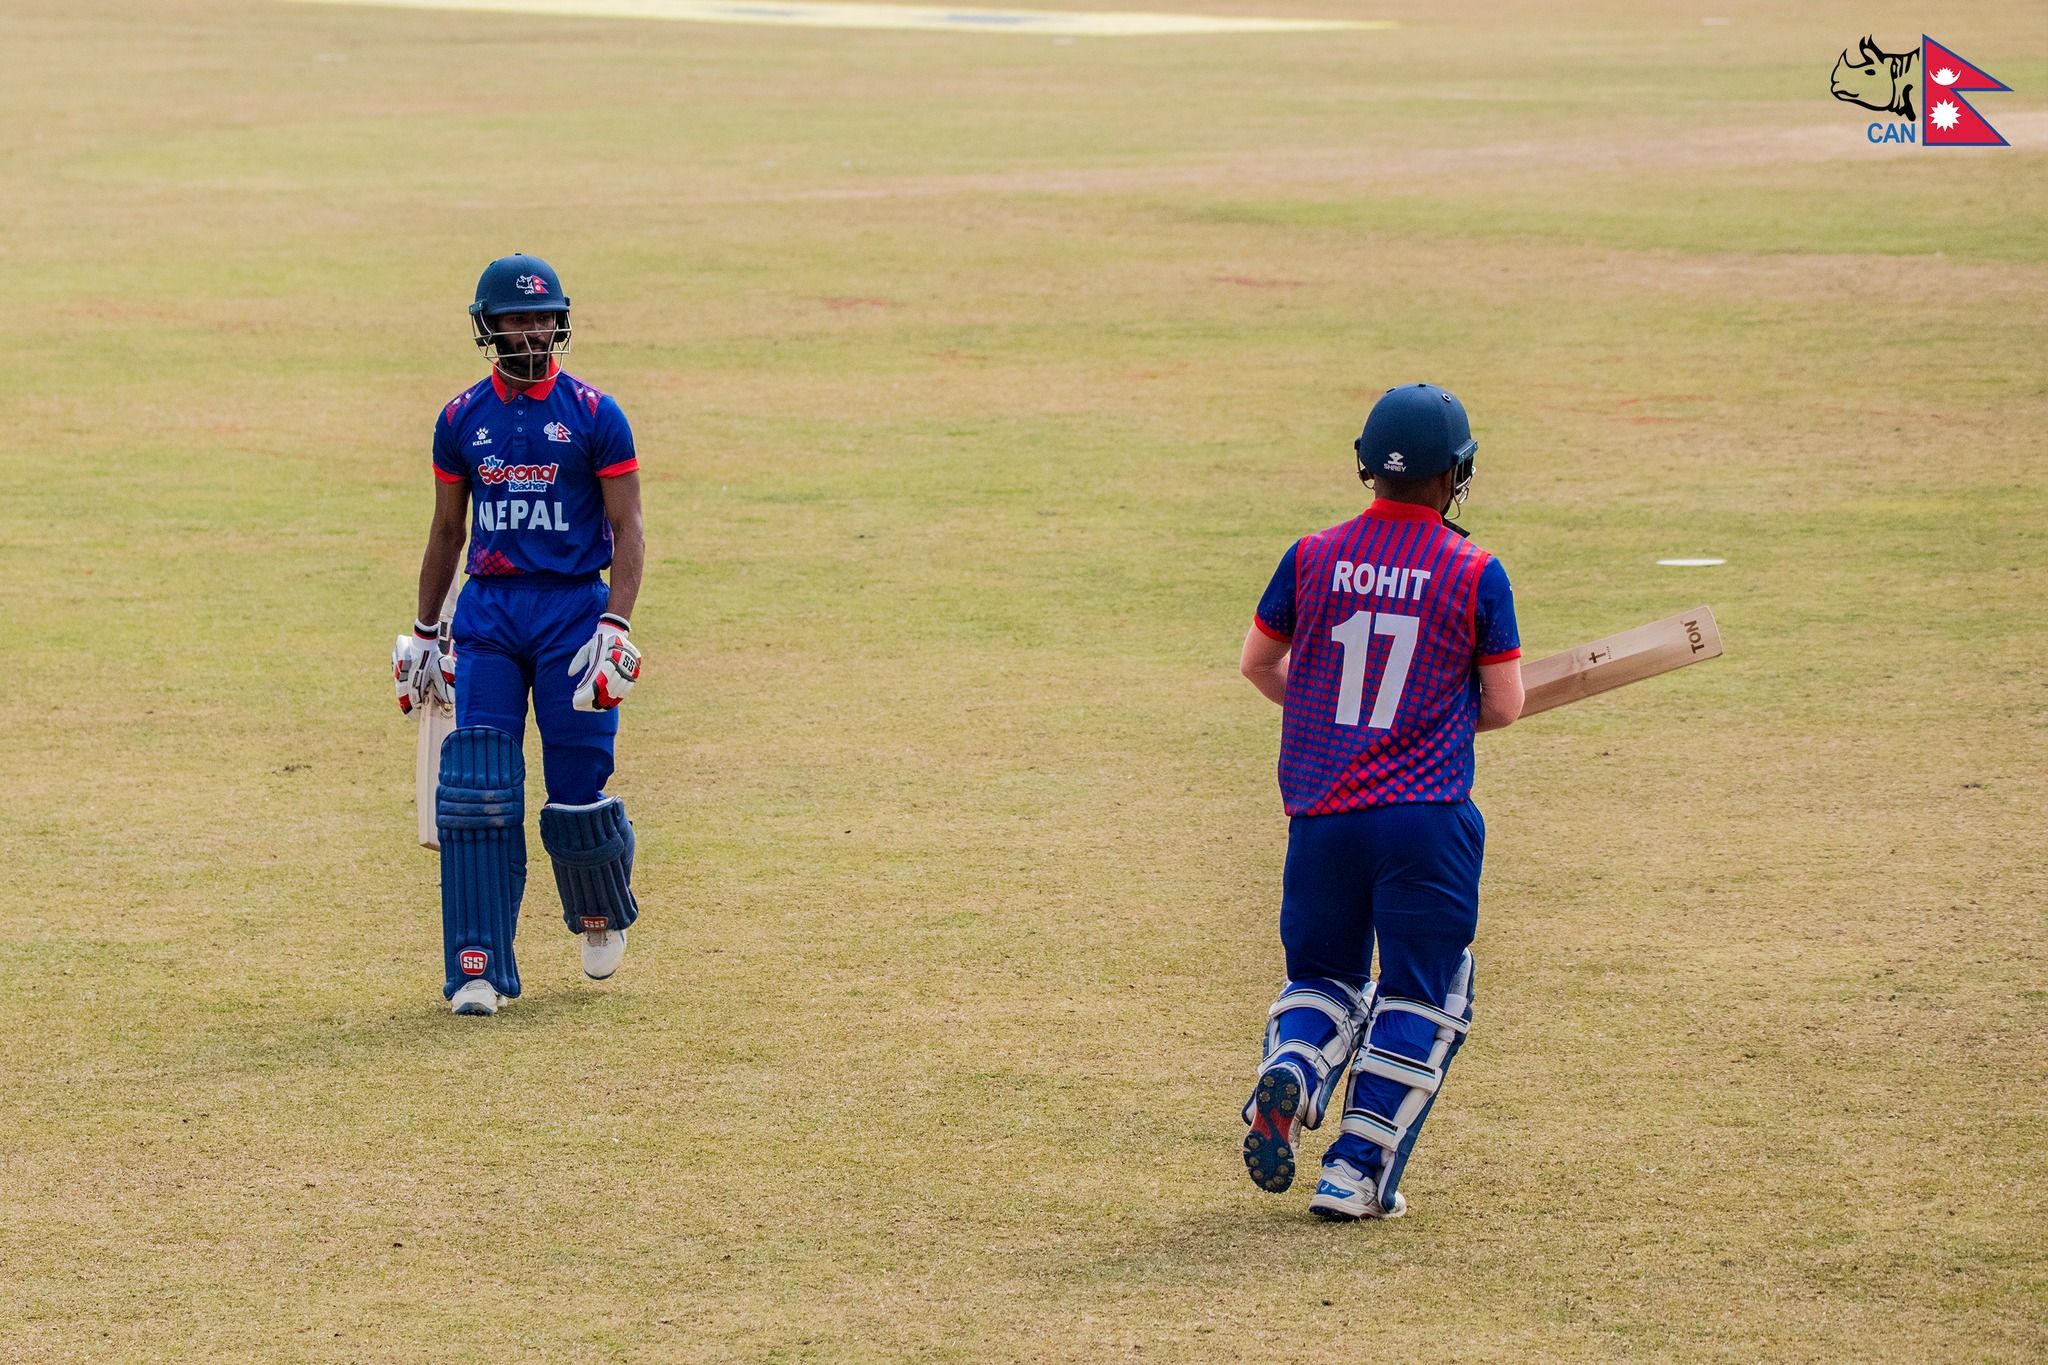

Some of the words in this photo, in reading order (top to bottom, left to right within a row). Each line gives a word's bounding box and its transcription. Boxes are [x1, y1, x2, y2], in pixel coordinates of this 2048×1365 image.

[472, 438, 492, 446] KELME
[483, 455, 504, 468] My
[1383, 463, 1407, 473] SHREY
[478, 463, 559, 485] Second
[508, 481, 547, 492] Teacher
[479, 500, 569, 531] NEPAL
[1332, 560, 1431, 600] ROHIT
[1684, 620, 1705, 654] TON
[622, 654, 636, 673] SS
[1331, 610, 1420, 729] 17
[463, 956, 484, 969] SS
